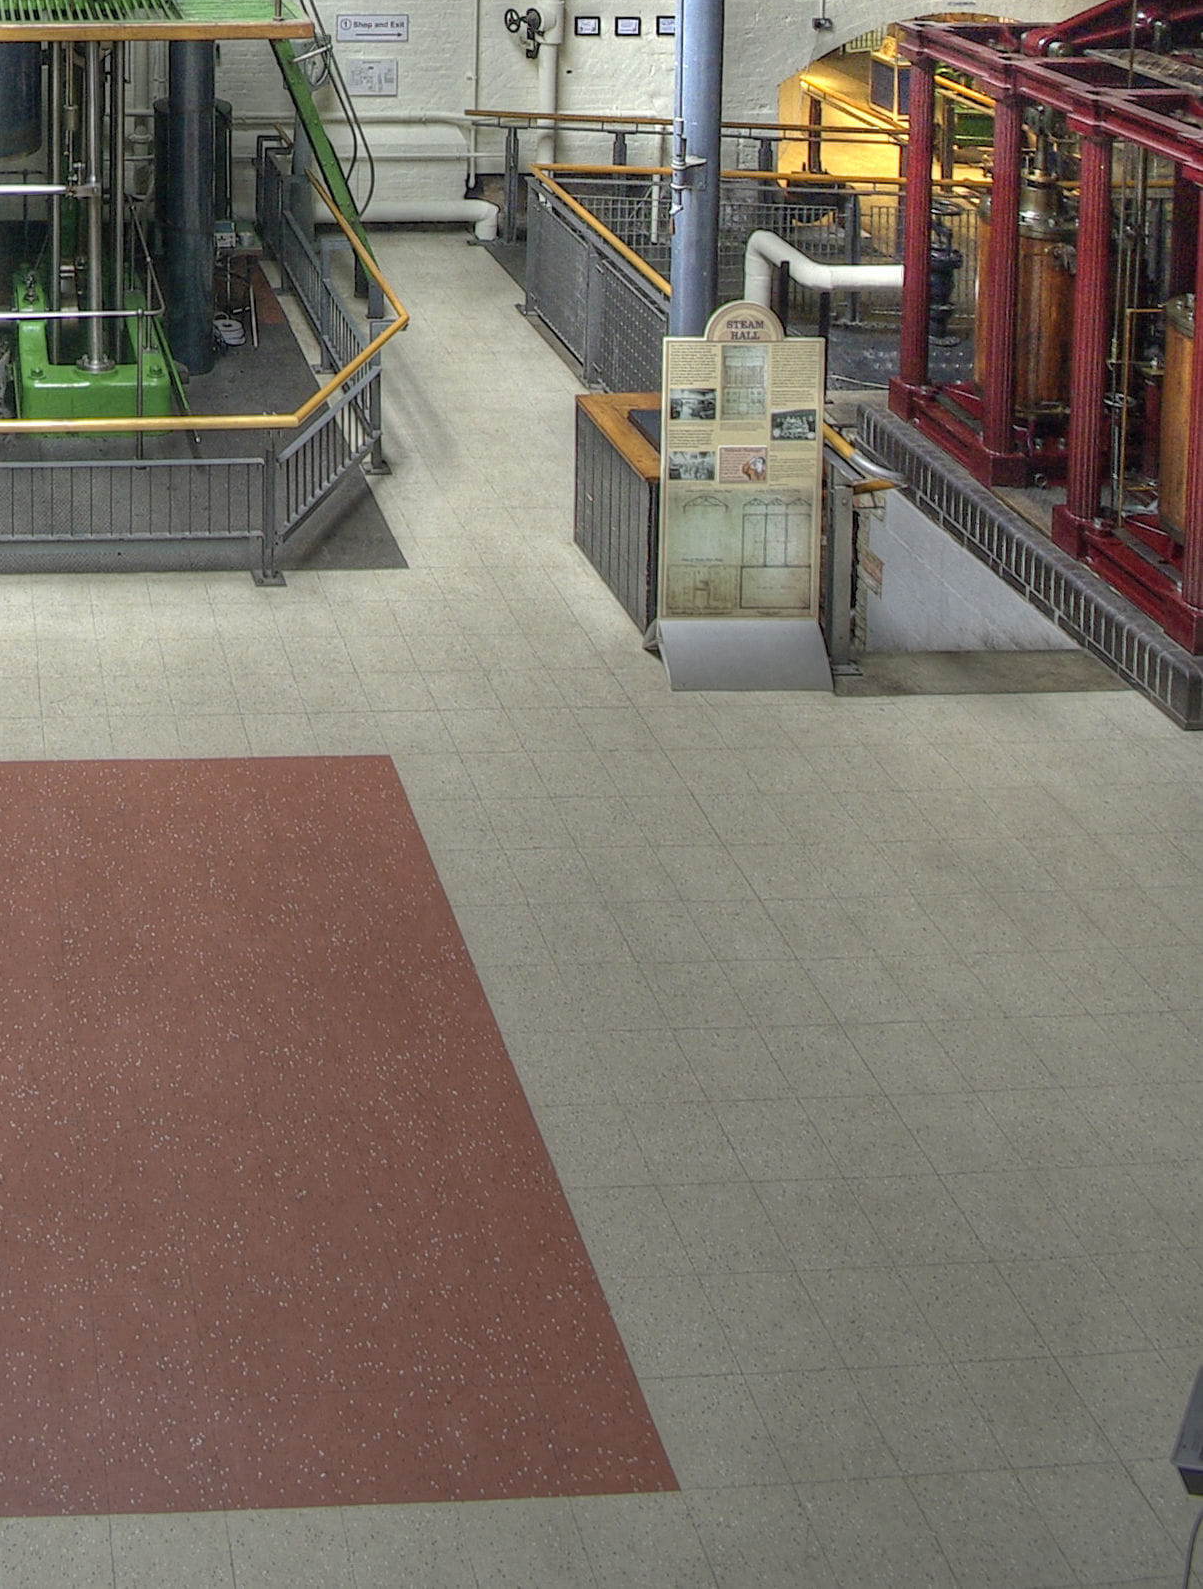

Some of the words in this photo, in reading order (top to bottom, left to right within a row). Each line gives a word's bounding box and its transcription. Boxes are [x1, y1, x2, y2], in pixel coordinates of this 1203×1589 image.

[353, 21, 373, 29] Shop
[726, 320, 764, 329] STEAM
[730, 330, 760, 340] HALL
